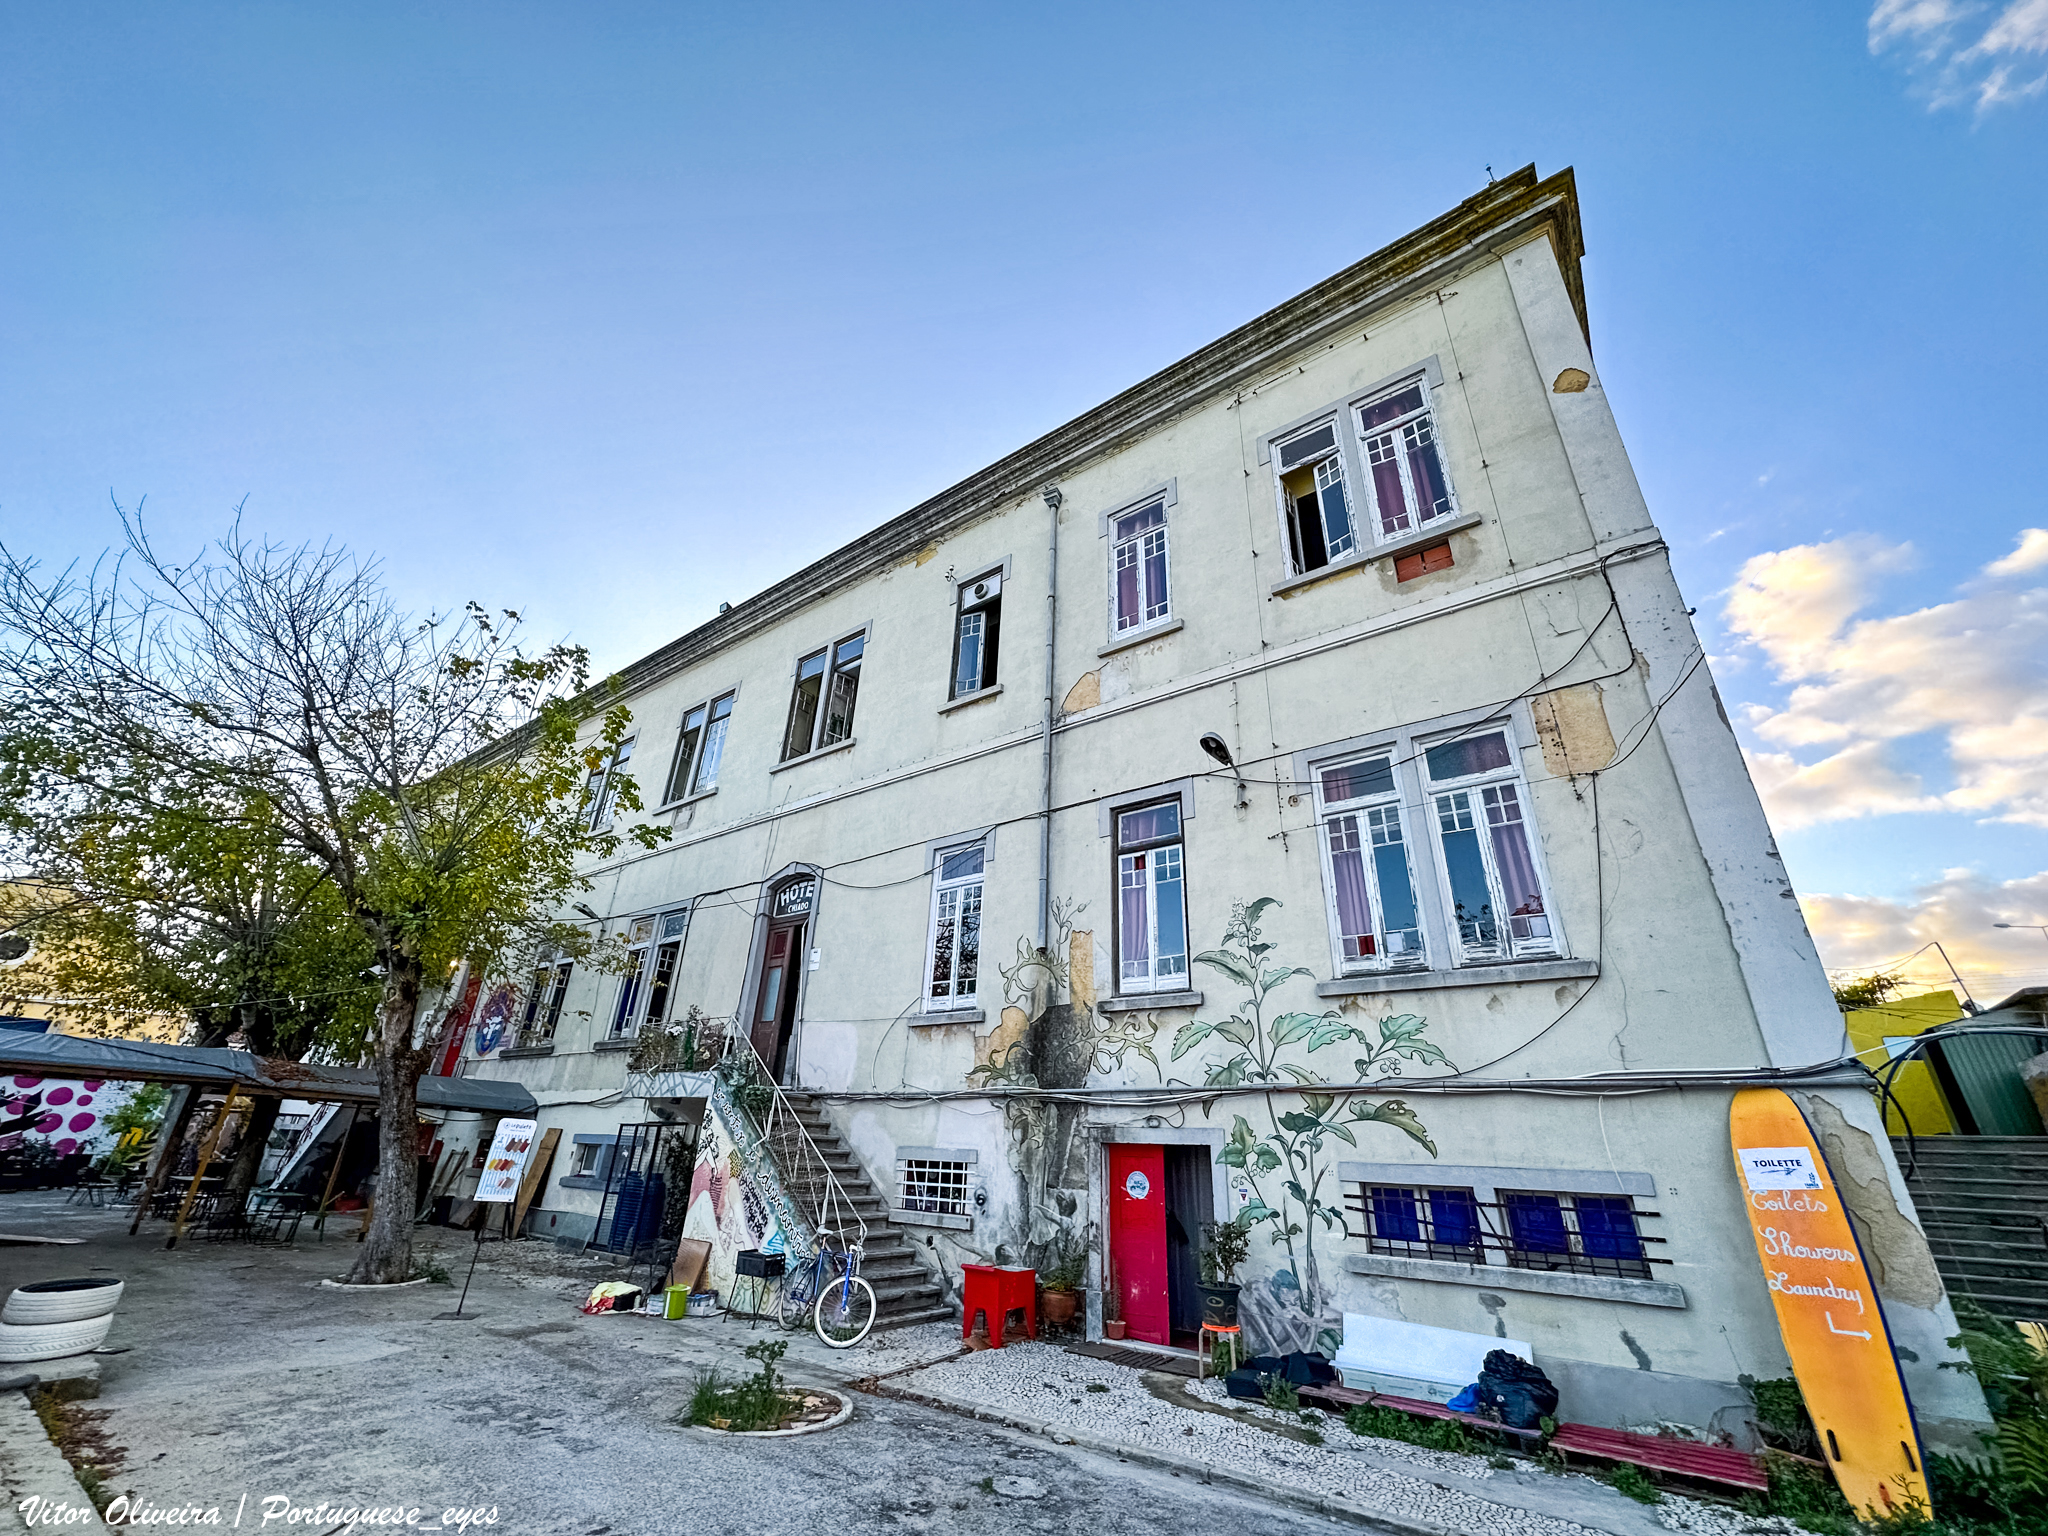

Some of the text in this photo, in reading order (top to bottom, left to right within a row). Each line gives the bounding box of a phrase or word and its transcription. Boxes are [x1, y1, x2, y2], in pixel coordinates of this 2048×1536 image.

[780, 881, 814, 906] HOTE
[788, 902, 809, 913] CHIADO
[1752, 1159, 1802, 1168] TOILETTE
[1748, 1189, 1828, 1212] Toilets
[1757, 1225, 1855, 1262] Showers
[1767, 1270, 1864, 1315] Laundry
